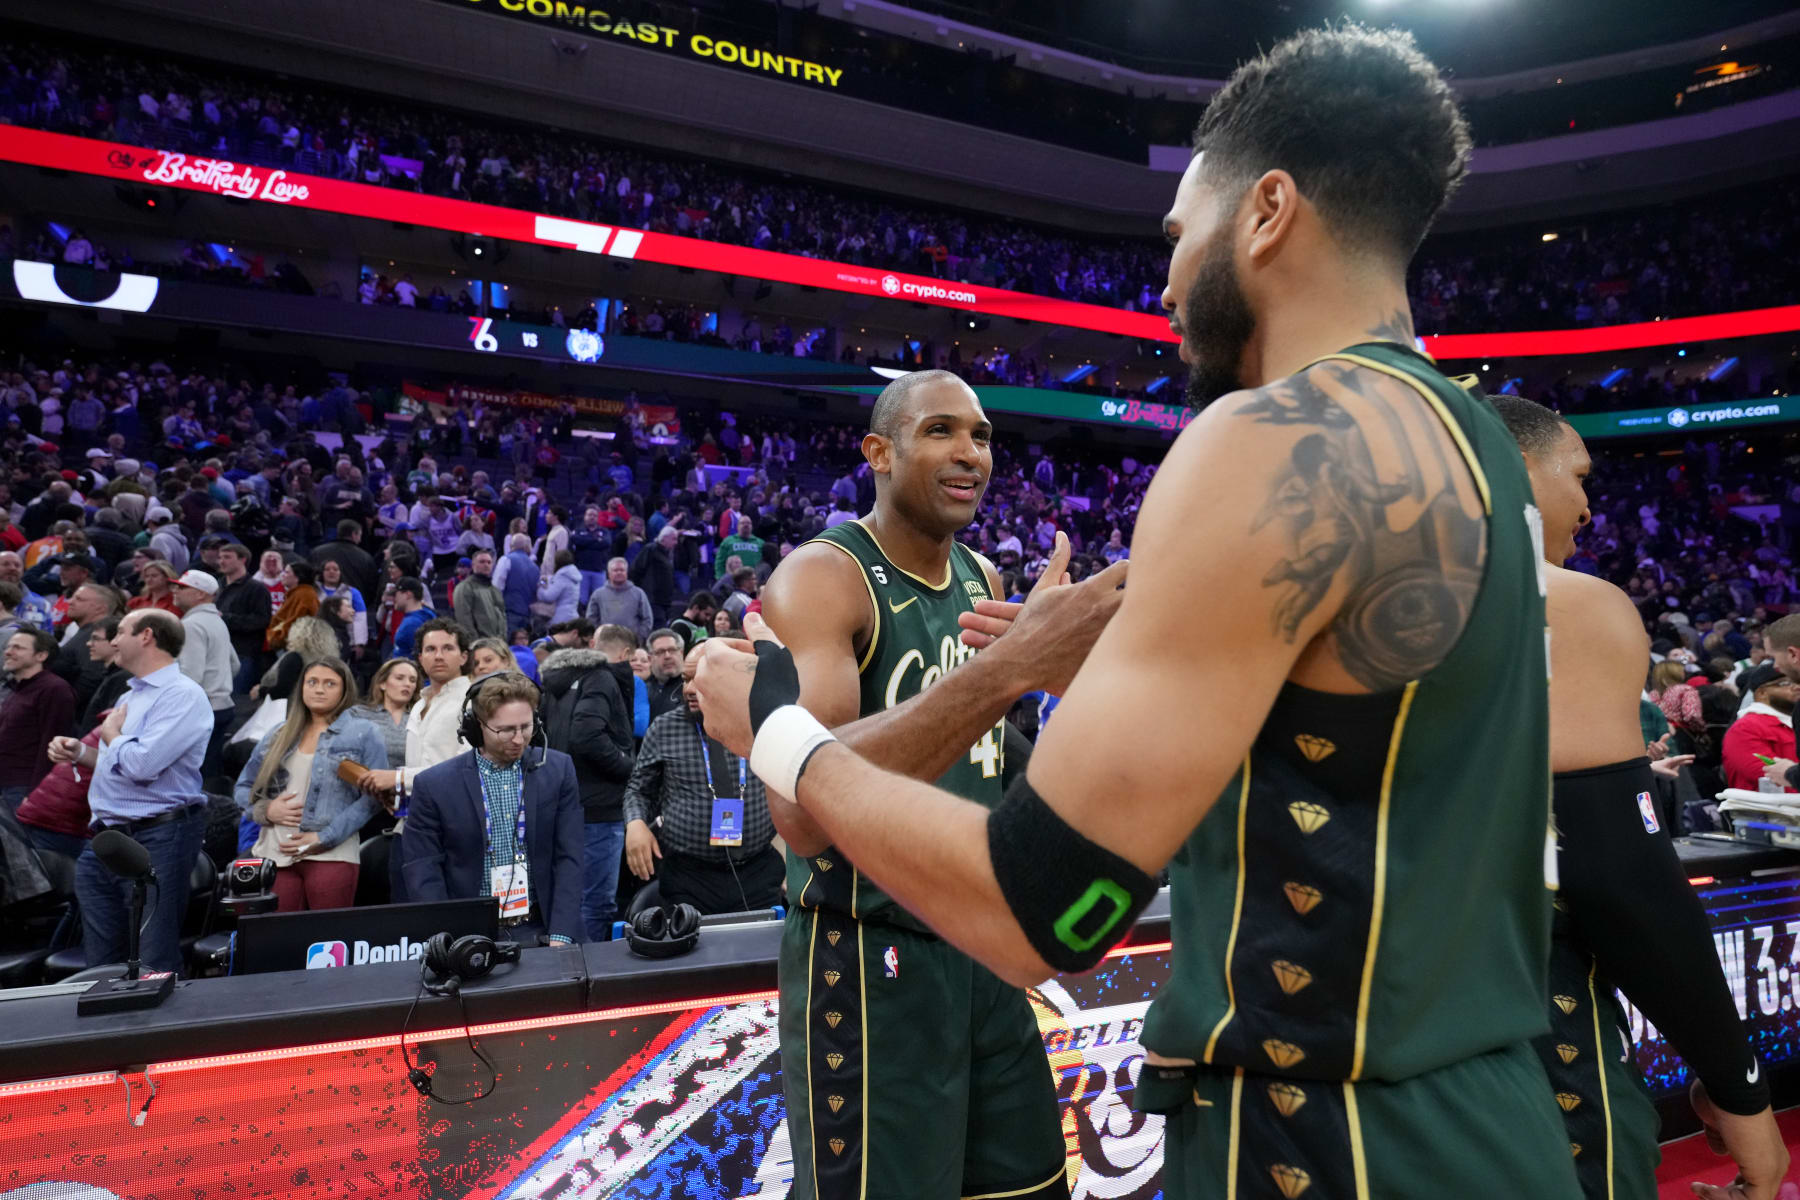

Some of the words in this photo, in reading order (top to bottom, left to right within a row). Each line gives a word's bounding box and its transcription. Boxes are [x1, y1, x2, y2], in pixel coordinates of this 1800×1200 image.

[499, 0, 680, 49] COMCAST
[690, 34, 844, 88] COUNTRY
[144, 150, 260, 199] Brotherly
[259, 170, 310, 202] Love
[902, 282, 976, 303] crypto.com
[1691, 404, 1780, 422] crypto.com
[871, 566, 888, 585] 6
[970, 715, 1005, 779] 4
